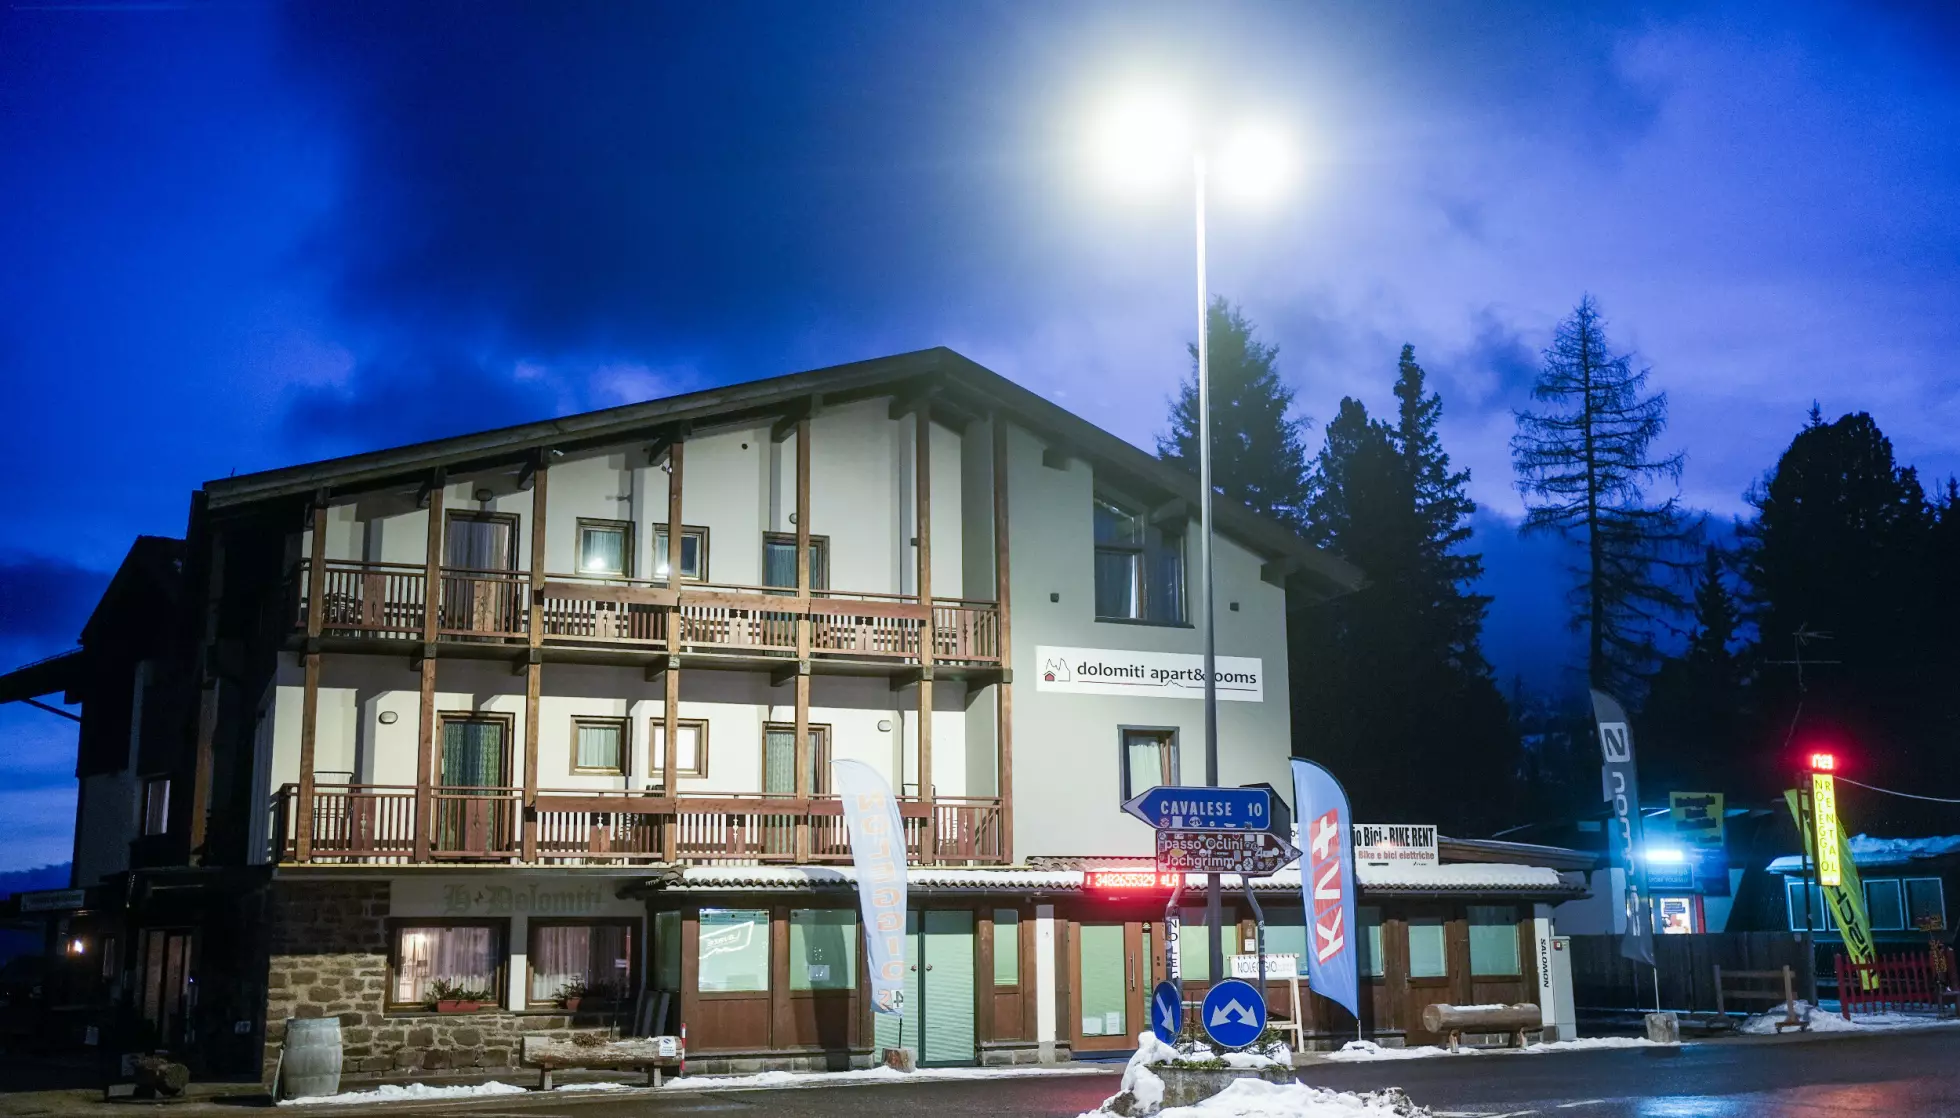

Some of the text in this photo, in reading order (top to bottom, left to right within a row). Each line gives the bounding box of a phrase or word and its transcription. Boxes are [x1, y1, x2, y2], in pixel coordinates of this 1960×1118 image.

[1077, 661, 1257, 684] dolomiti apart&ooms
[1160, 801, 1262, 816] CAVALESE 10
[1814, 780, 1829, 872] NOLEGGIO
[1824, 781, 1837, 873] RENTAL
[1164, 838, 1243, 851] passo Oclini
[1364, 827, 1382, 846] Bici
[1389, 827, 1410, 847] BIKE
[1412, 827, 1434, 847] RENT
[1165, 854, 1235, 868] Jochgrimm
[1358, 850, 1374, 859] Bike
[1383, 851, 1398, 860] bici
[1400, 851, 1435, 860] elettriche
[1539, 937, 1550, 988] SALOMON
